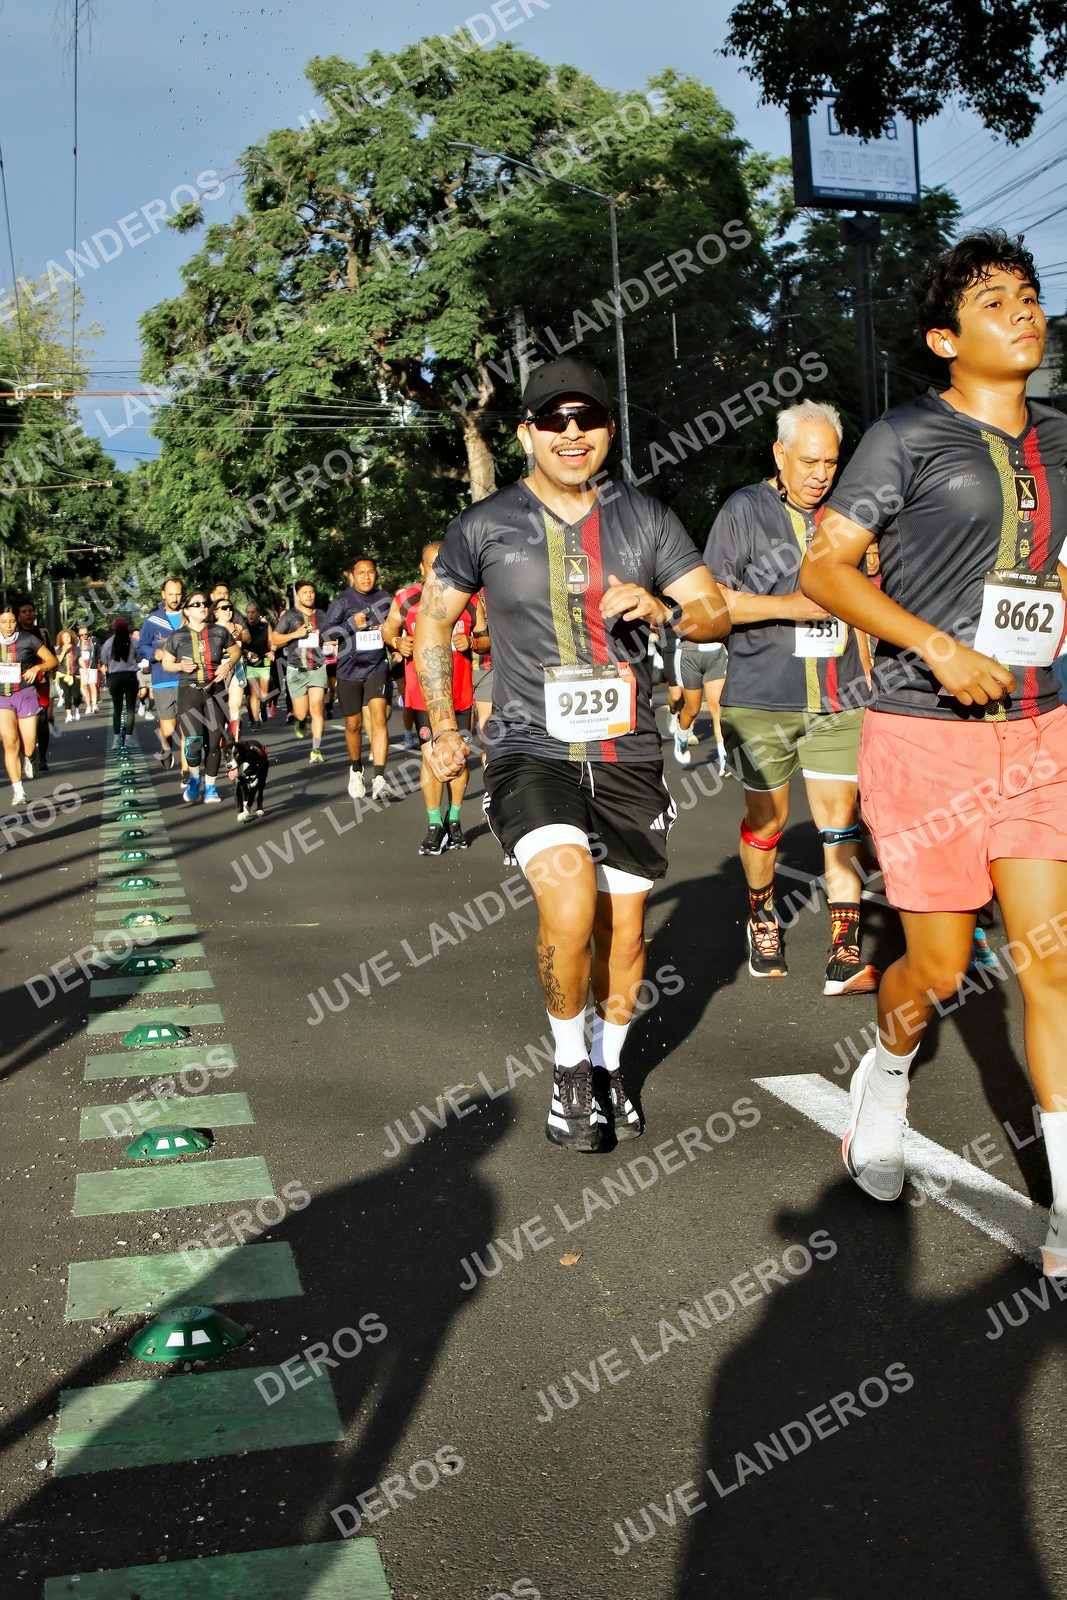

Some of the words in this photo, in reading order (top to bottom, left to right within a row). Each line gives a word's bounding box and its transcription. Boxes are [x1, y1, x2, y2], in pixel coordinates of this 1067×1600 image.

[995, 599, 1054, 633] 8662
[358, 631, 381, 642] 10328
[805, 620, 839, 638] 2531
[558, 688, 619, 716] 9239
